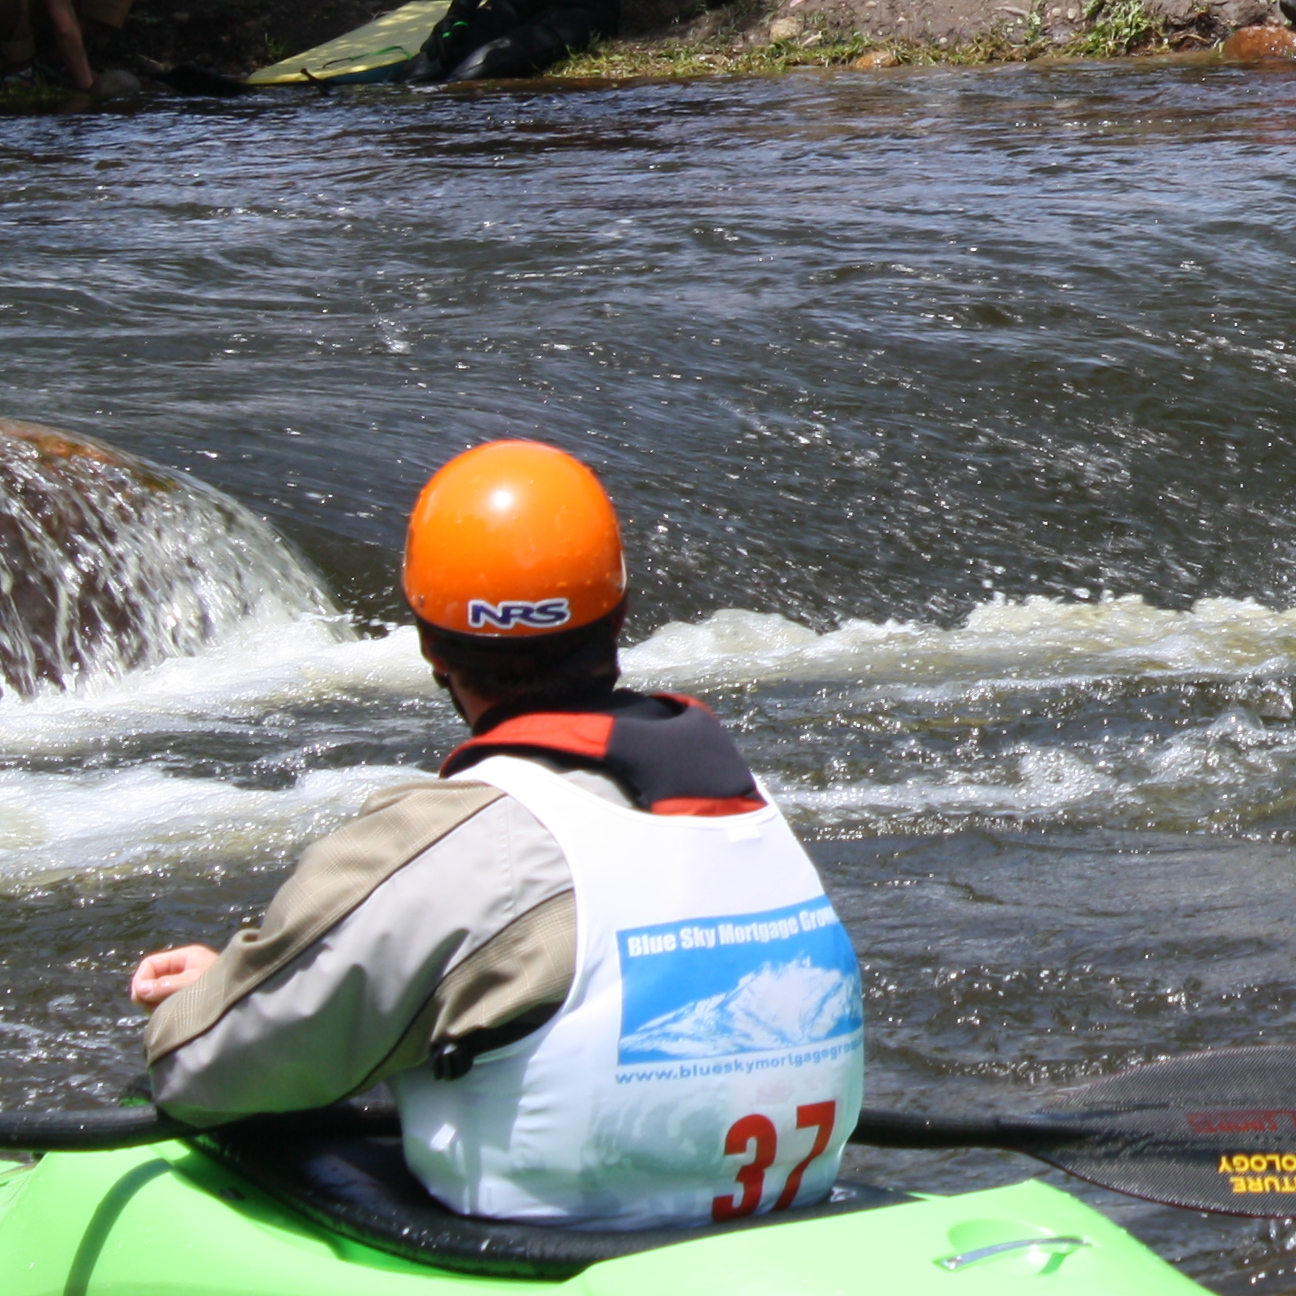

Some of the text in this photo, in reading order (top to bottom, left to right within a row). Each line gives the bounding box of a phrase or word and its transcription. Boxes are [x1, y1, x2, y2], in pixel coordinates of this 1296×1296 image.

[469, 599, 570, 628] NRS
[628, 906, 839, 957] Blue Sky Mortgage Grou
[712, 1100, 836, 1222] 37
